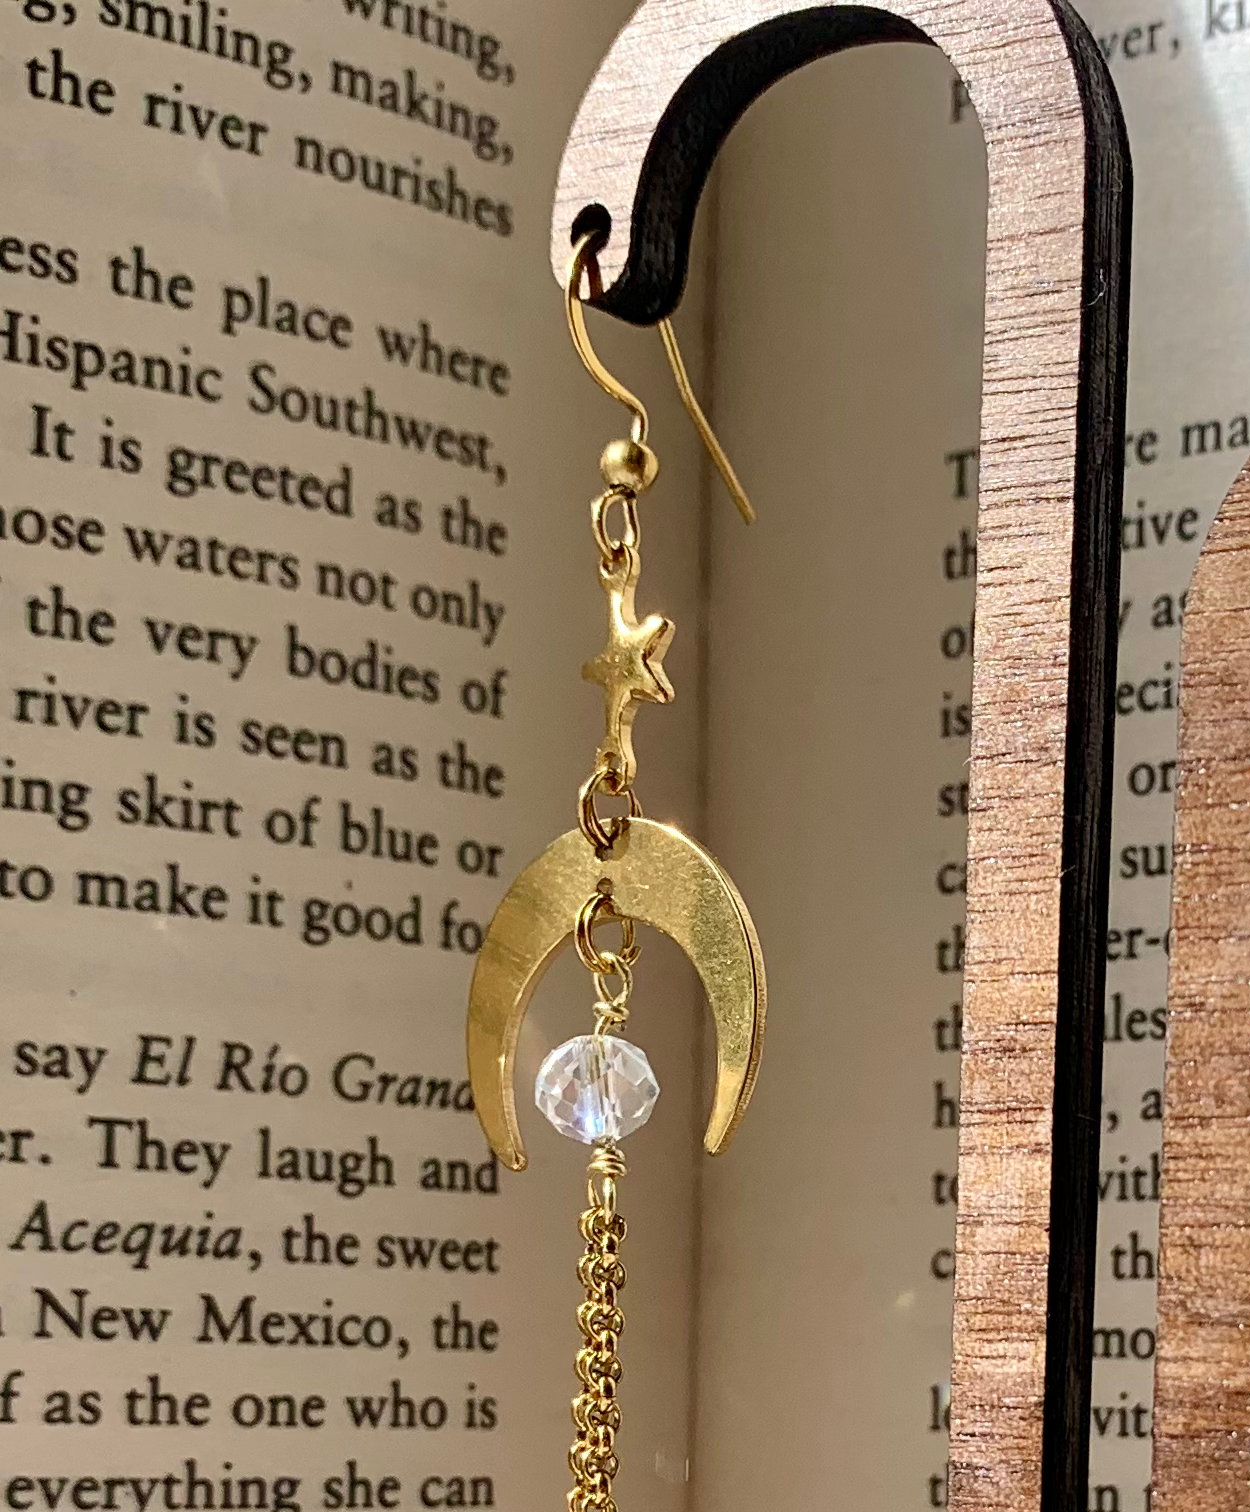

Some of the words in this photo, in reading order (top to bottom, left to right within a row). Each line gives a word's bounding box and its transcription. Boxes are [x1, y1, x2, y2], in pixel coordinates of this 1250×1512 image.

[98, 0, 313, 95] smiling,
[329, 58, 516, 167] making,
[143, 82, 270, 157] river
[293, 127, 514, 239] nourishes
[221, 275, 354, 350] place
[376, 320, 511, 398] where
[247, 361, 507, 487] Southwest,
[28, 402, 76, 464] It
[164, 445, 354, 519] greeted
[440, 495, 508, 557] the
[122, 522, 301, 592] waters
[315, 561, 398, 612] not
[410, 580, 507, 648] only
[142, 616, 261, 682] very
[285, 623, 443, 706] bodies
[459, 666, 508, 720] of
[12, 674, 150, 739] river
[239, 718, 350, 771] seen
[436, 740, 506, 800] the
[115, 772, 244, 839] skirt
[338, 799, 440, 868] blue
[455, 839, 506, 879] or
[75, 861, 230, 922] make
[246, 874, 286, 929] it
[300, 894, 425, 947] good
[13, 1040, 109, 1096] say
[129, 1033, 197, 1089] El
[213, 1040, 310, 1099] Río
[86, 1115, 232, 1190] They
[257, 1125, 397, 1200] laugh
[6, 1199, 264, 1272] Acequia,
[375, 1234, 500, 1275] sweet
[31, 1286, 173, 1343] New
[195, 1292, 410, 1360] Mexico,
[431, 1300, 500, 1354] the
[123, 1373, 212, 1429] the
[230, 1393, 327, 1430] one
[345, 1378, 449, 1432] who
[321, 1459, 402, 1511] she
[417, 1475, 495, 1510] can
